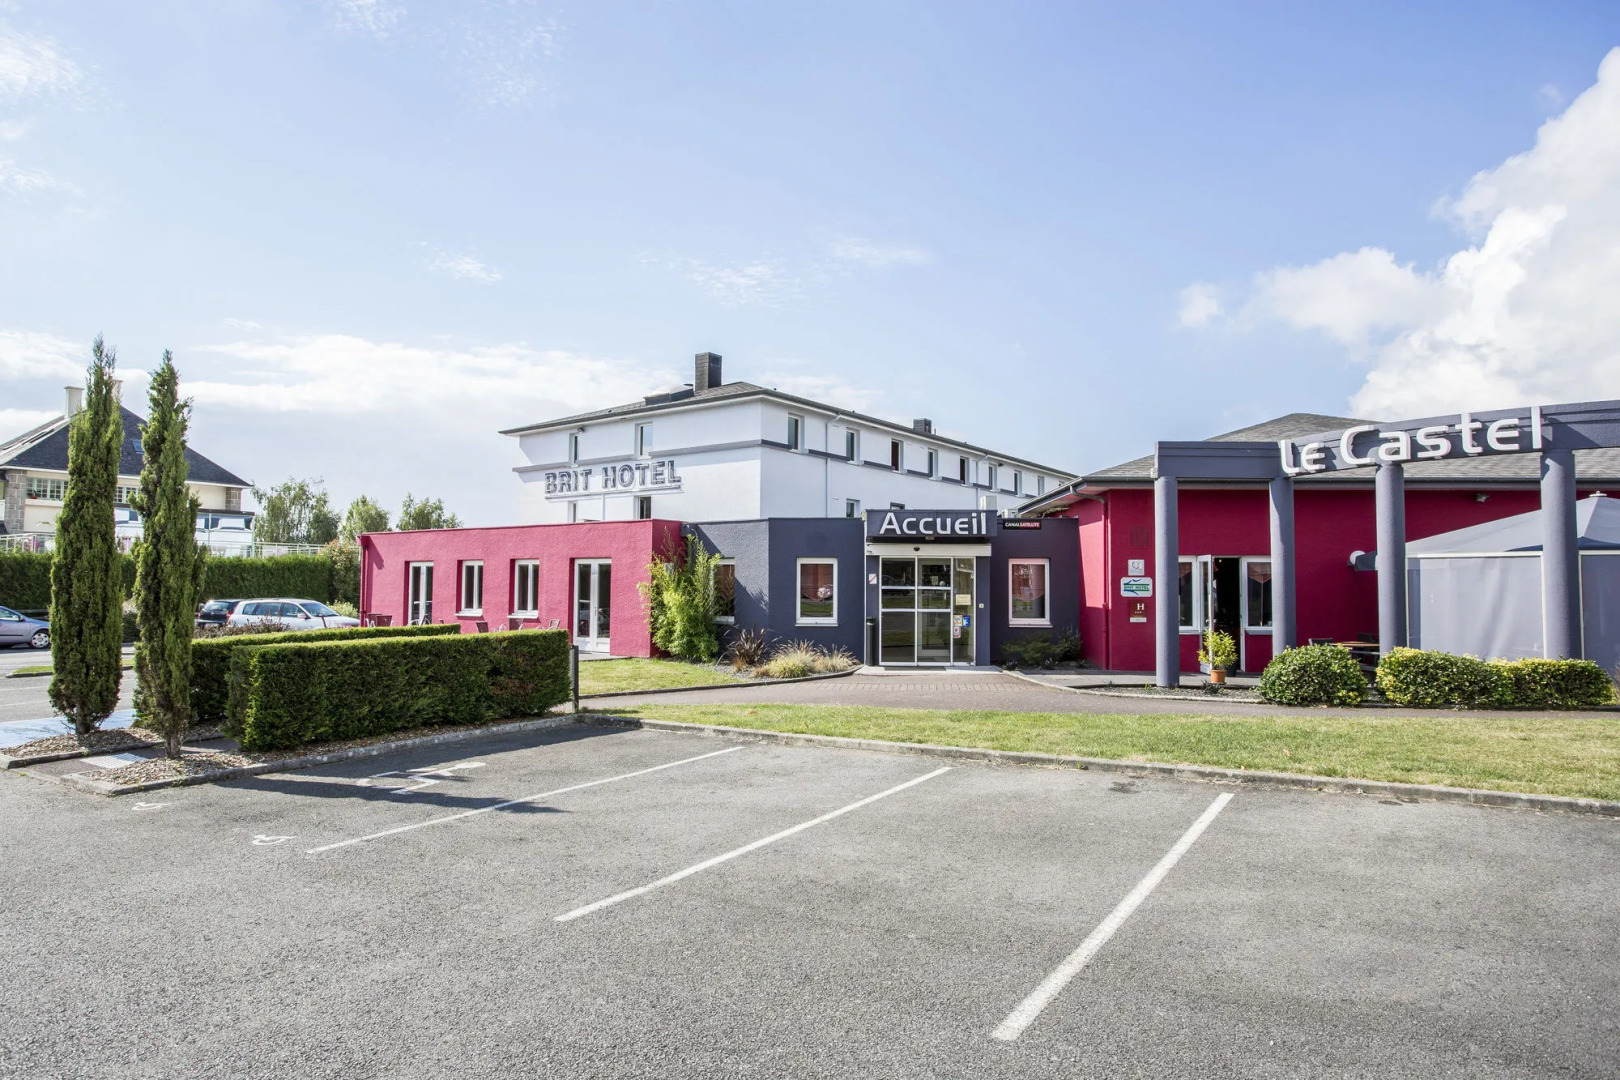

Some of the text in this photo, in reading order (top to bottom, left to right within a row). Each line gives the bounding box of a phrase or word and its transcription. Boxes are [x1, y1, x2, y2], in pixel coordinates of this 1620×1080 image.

[1339, 406, 1543, 465] Castel
[544, 460, 682, 495] BRIT HOTEL
[879, 511, 987, 535] Accueil
